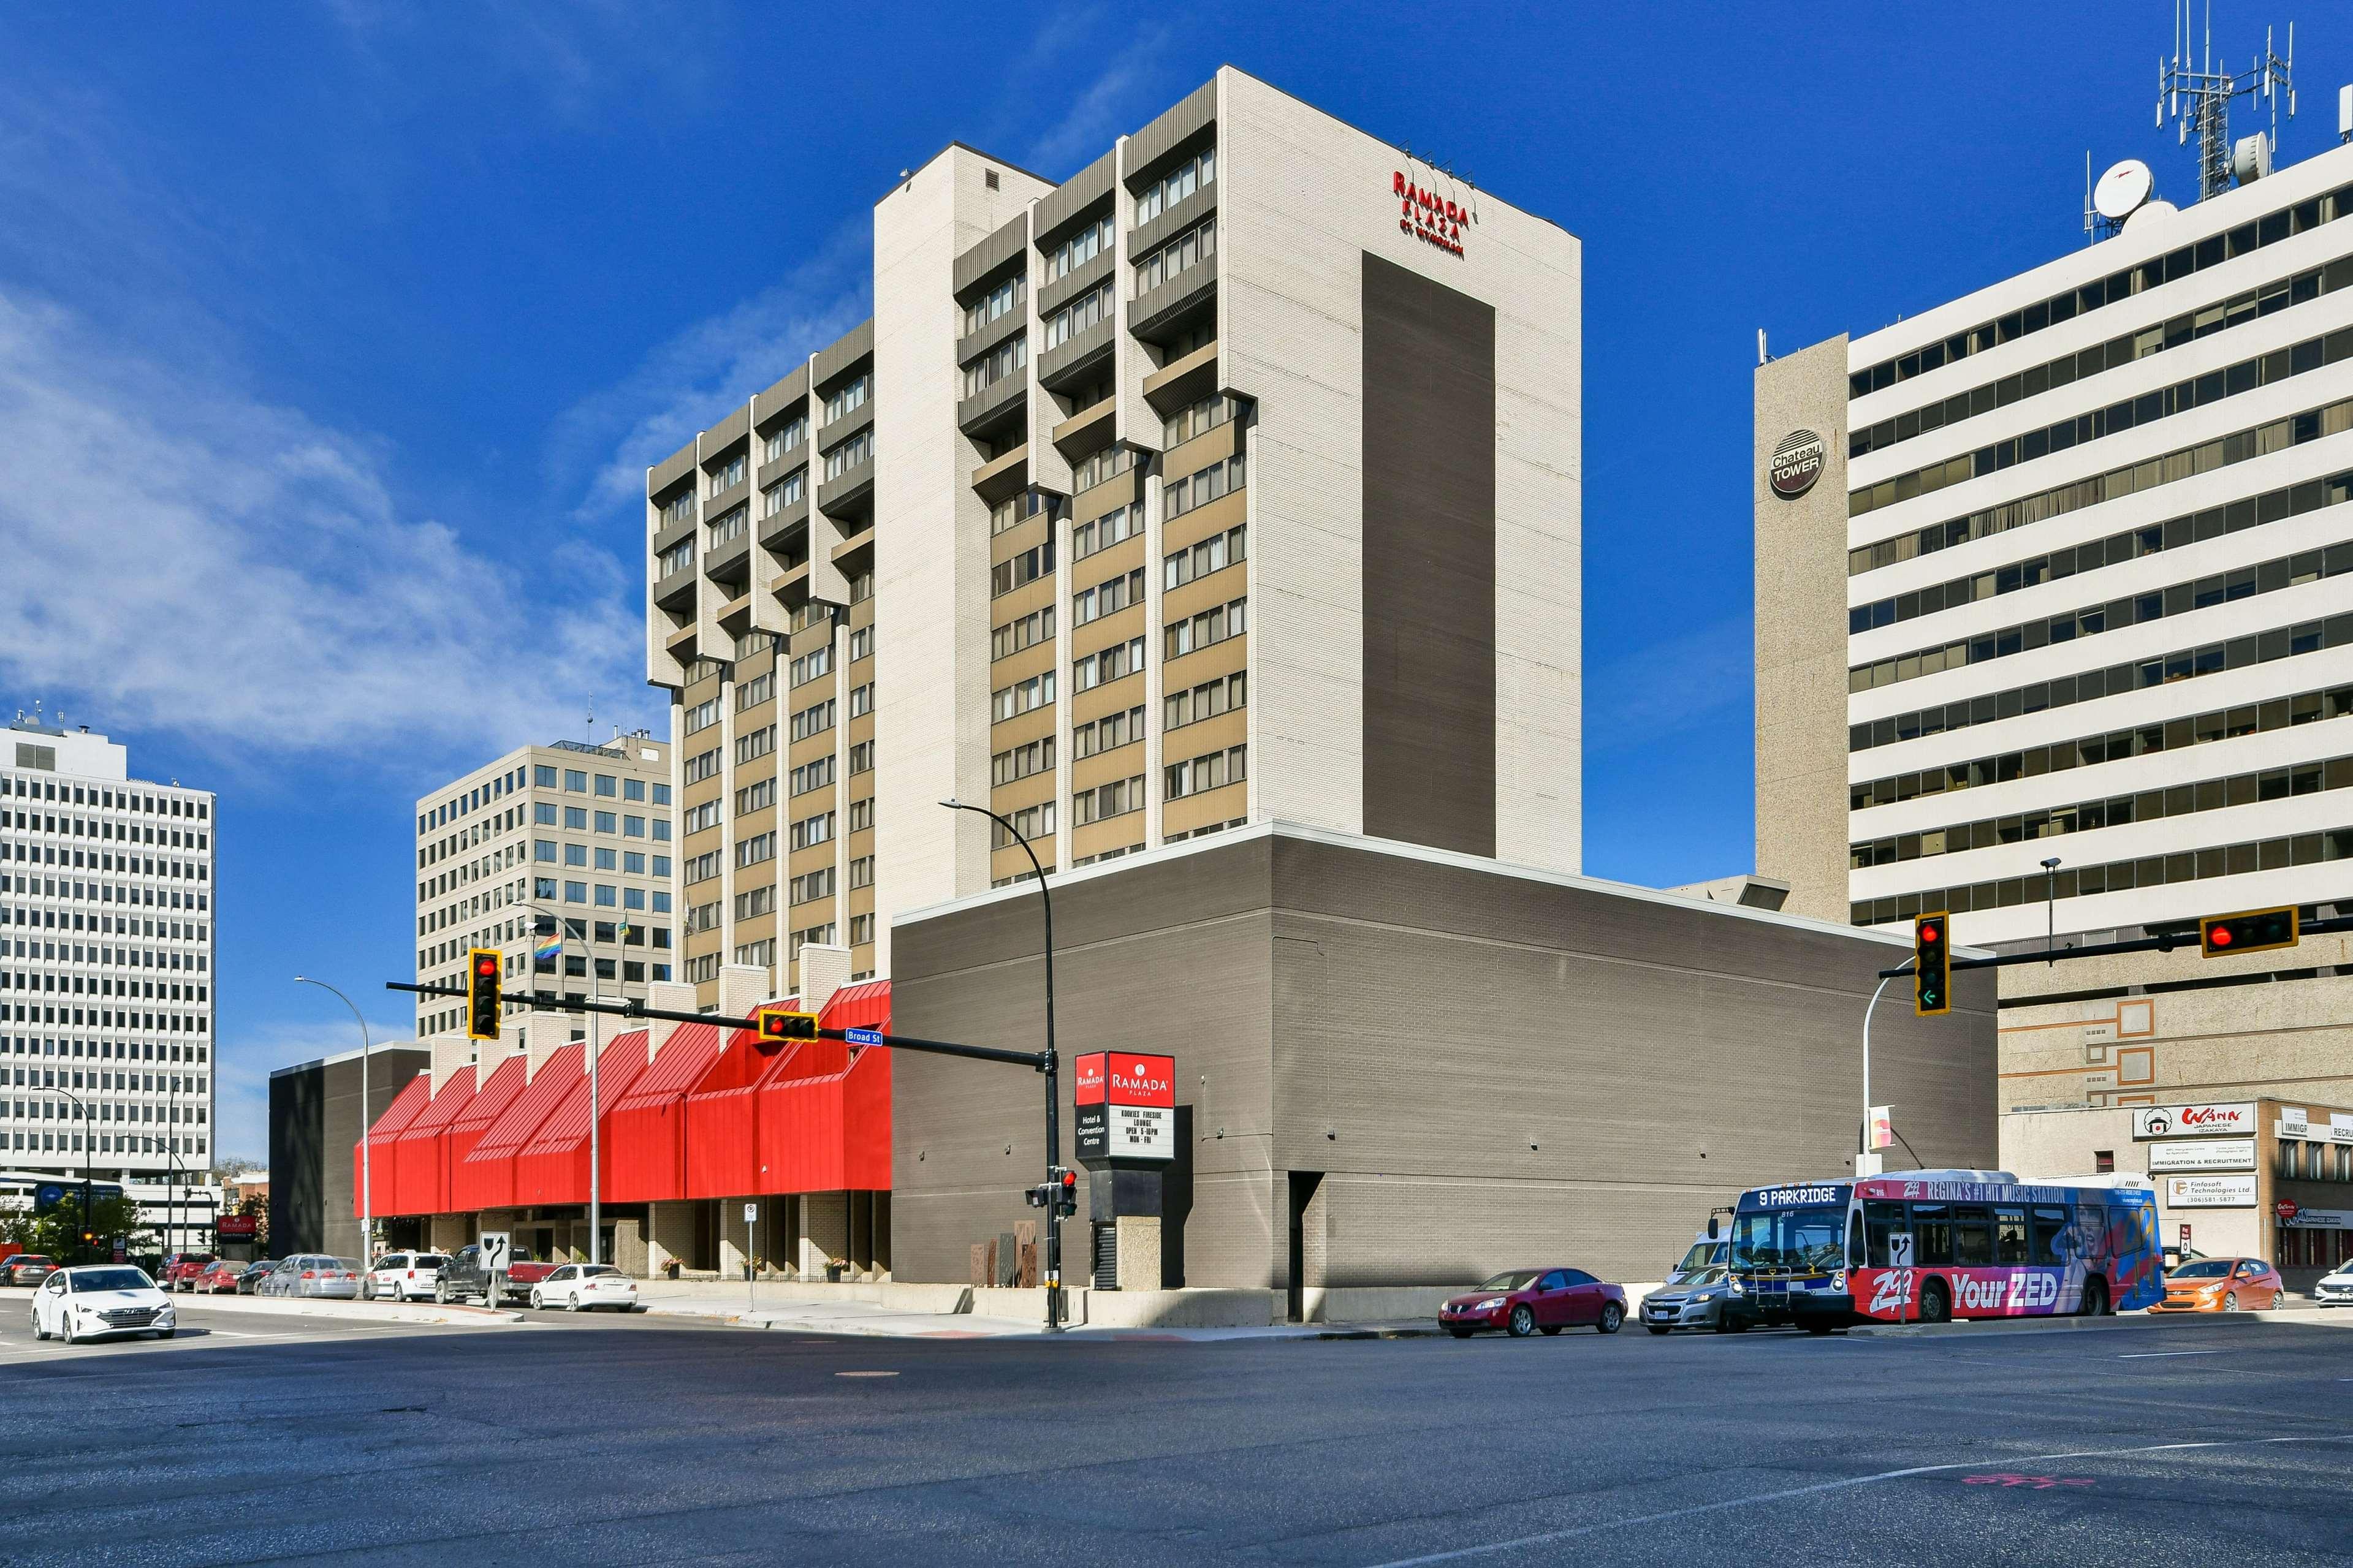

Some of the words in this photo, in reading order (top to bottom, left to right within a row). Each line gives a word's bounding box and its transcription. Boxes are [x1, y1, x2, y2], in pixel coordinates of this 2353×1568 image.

[1394, 171, 1469, 225] RAMADA
[1402, 200, 1459, 240] PLAZA
[1773, 445, 1819, 468] Chateau
[1774, 456, 1819, 482] TOWER
[848, 1031, 870, 1042] Broad
[872, 1034, 880, 1043] St
[1078, 1077, 1103, 1086] RAMADA
[1112, 1074, 1167, 1091] RAMADA
[1082, 1116, 1096, 1124] Hotel
[1078, 1126, 1104, 1135] Convention
[1759, 1191, 1767, 1206] 9
[1771, 1187, 1836, 1205] PARKRIDGE
[1927, 1181, 1971, 1201] REGINA'S
[1974, 1184, 1983, 1201] #1
[1985, 1184, 1999, 1202] HIT
[2002, 1185, 2030, 1202] MUSIC
[2032, 1186, 2065, 1203] STATION
[1951, 1274, 2007, 1309] Your
[2008, 1273, 2058, 1308] ZED
